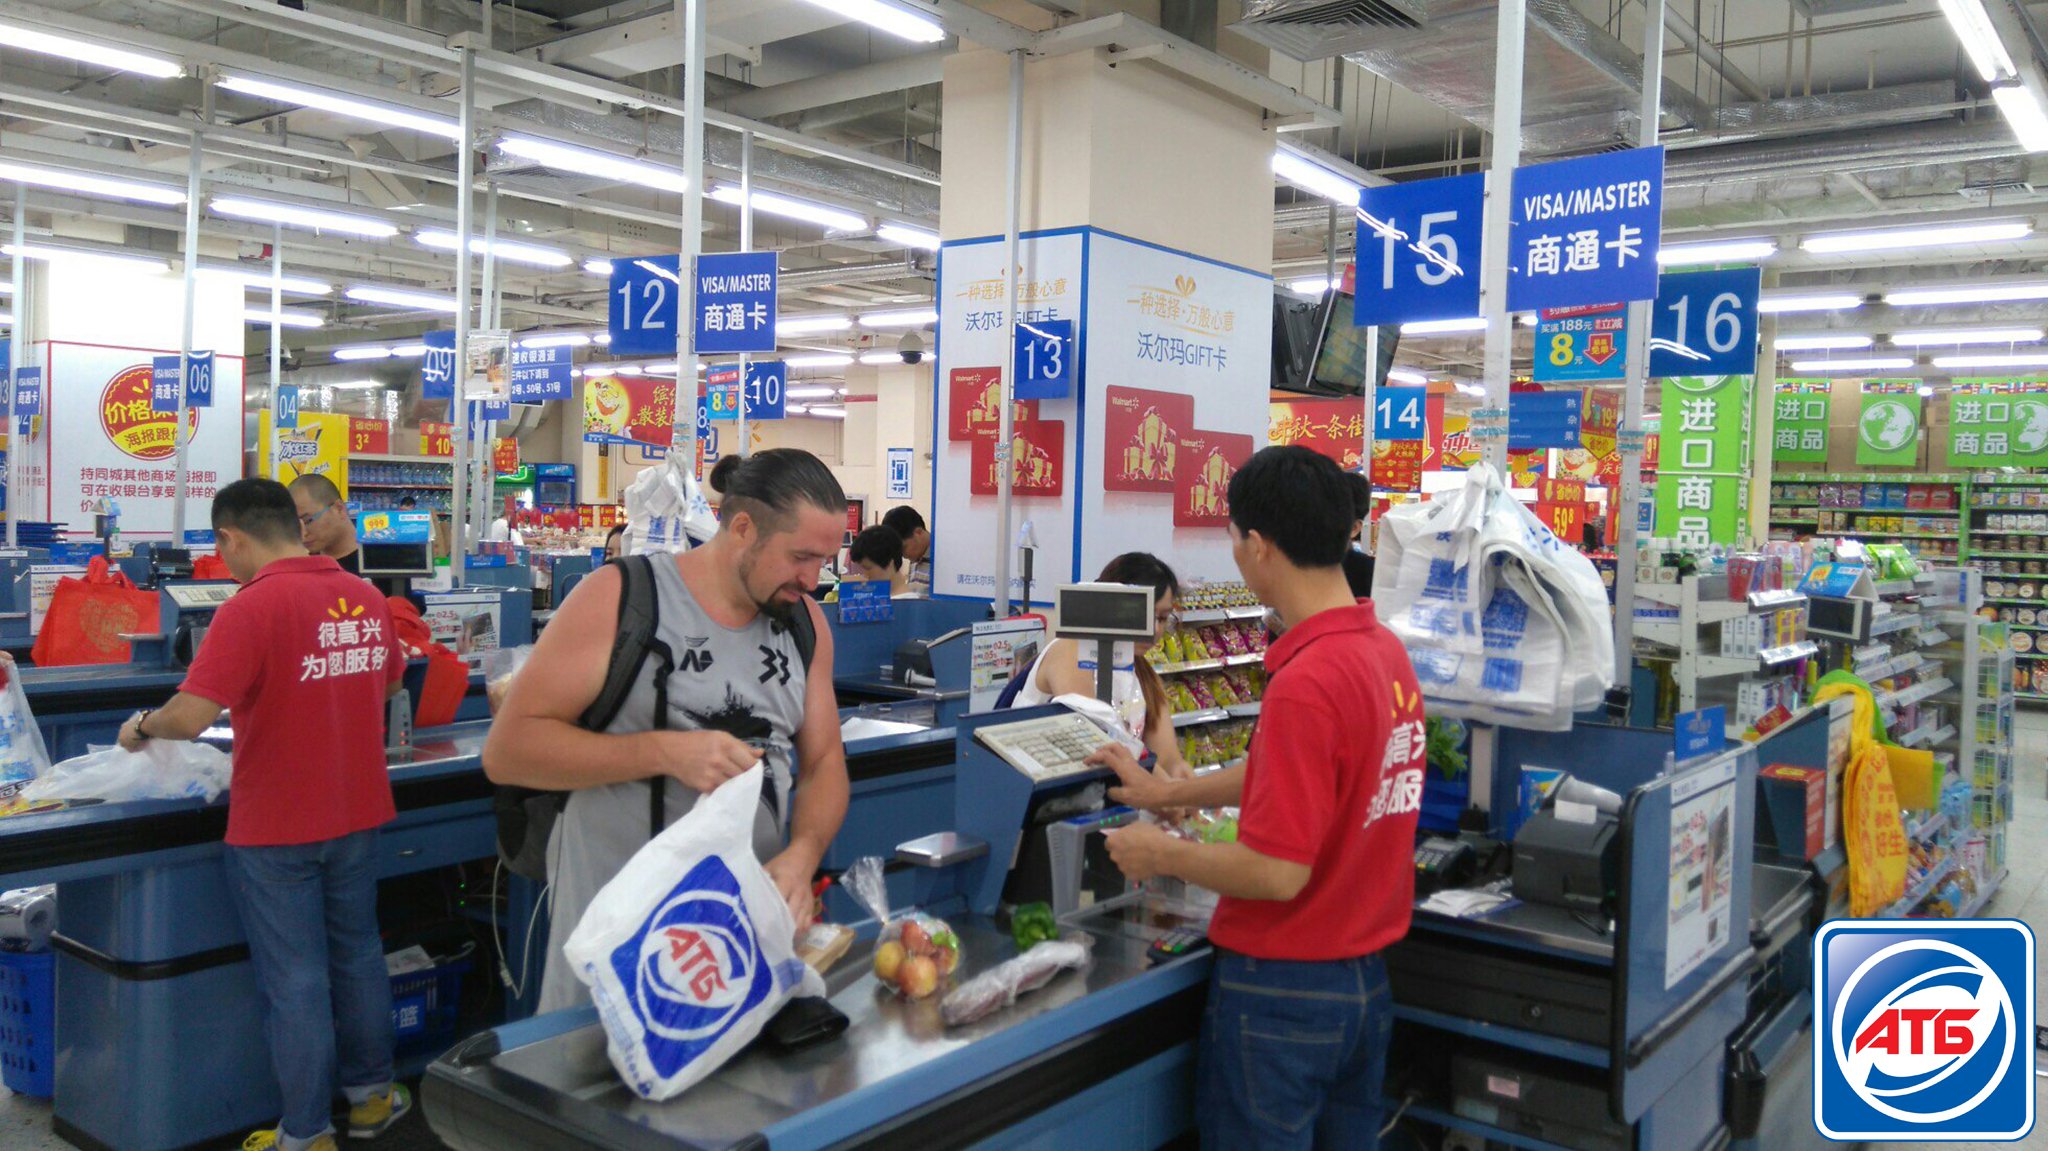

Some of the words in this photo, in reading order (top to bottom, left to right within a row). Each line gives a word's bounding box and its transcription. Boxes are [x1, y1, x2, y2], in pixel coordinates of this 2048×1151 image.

[1523, 179, 1651, 223] VISA/MASTER
[1373, 210, 1459, 290] 15
[1526, 224, 1643, 278] 商通卡
[702, 273, 771, 294] VISA/MASTER
[618, 278, 666, 331] 12
[704, 301, 768, 332] 商通卡
[1666, 292, 1742, 354] 16
[1023, 339, 1062, 380] 13
[1137, 331, 1227, 372] 沃尔玛GIFT卡
[190, 364, 209, 394] 06
[752, 375, 779, 406] 10
[279, 395, 297, 419] 04
[1377, 397, 1420, 430] 14
[1776, 399, 1825, 421] 进口
[1955, 401, 2009, 424] 进口
[1776, 428, 1824, 451] 商品
[1954, 431, 2008, 455] 商品
[80, 467, 217, 483] 持同城其他商场报即
[318, 617, 382, 648] 很高兴
[300, 646, 389, 682] 为您服务
[758, 643, 791, 687] 33
